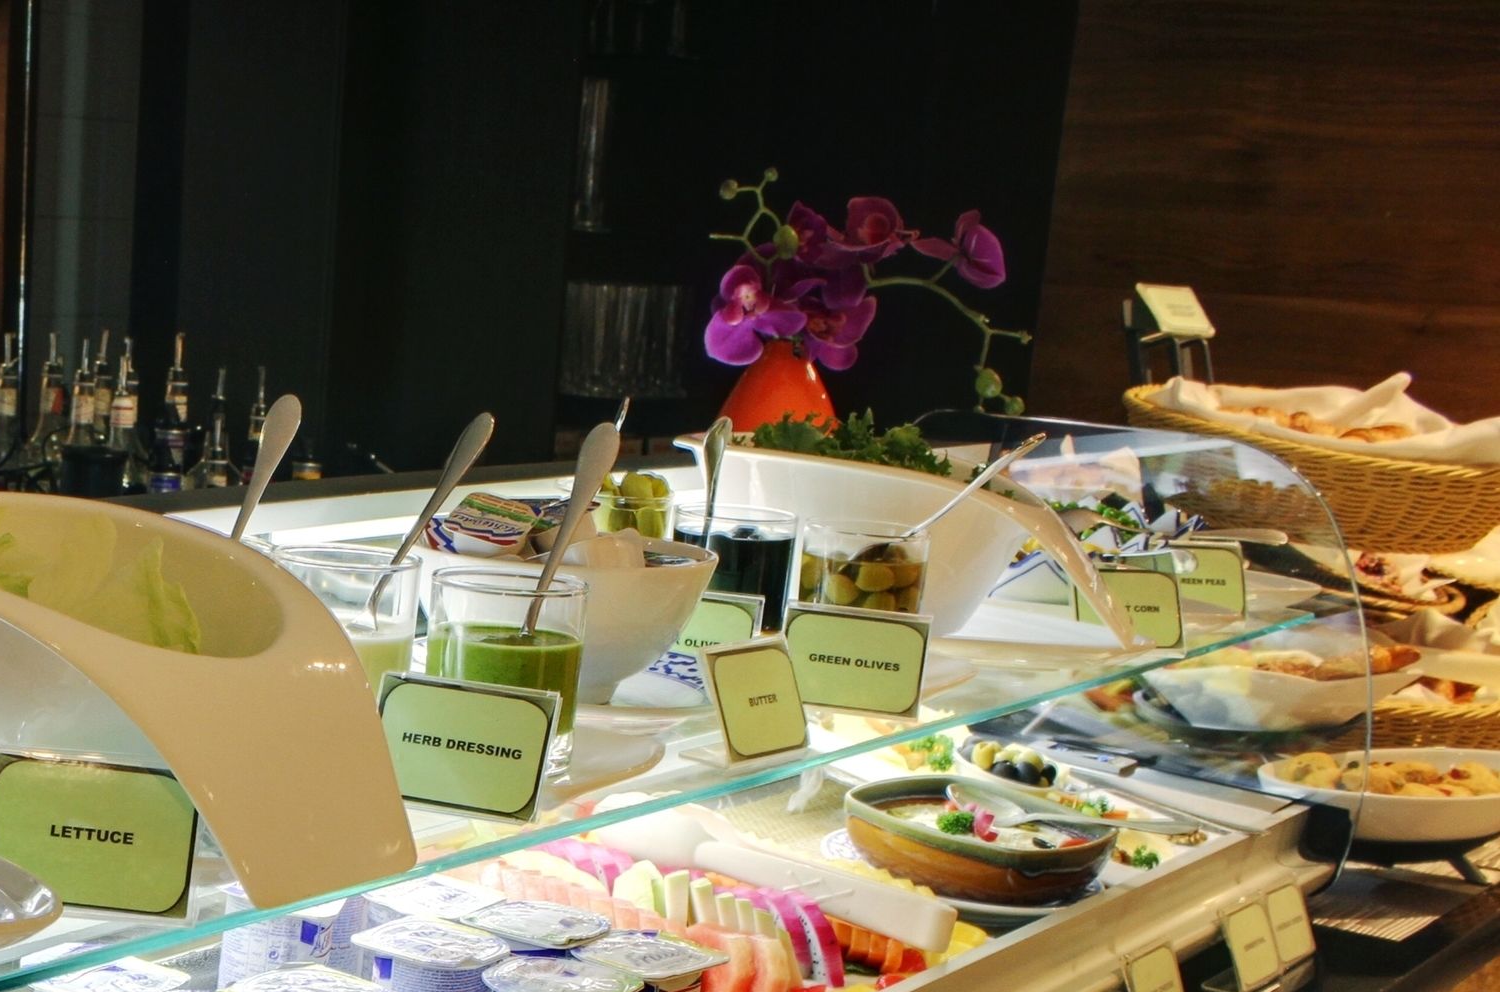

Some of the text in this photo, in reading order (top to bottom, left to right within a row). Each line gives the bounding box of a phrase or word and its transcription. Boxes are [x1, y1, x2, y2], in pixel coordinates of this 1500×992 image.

[1181, 578, 1203, 586] REEN
[1133, 605, 1160, 613] CORN
[808, 652, 901, 672] GREEN OLIVES
[748, 693, 778, 707] BUTTER
[402, 731, 523, 760] HERB DRESSING
[49, 824, 135, 845] LETTUCE
